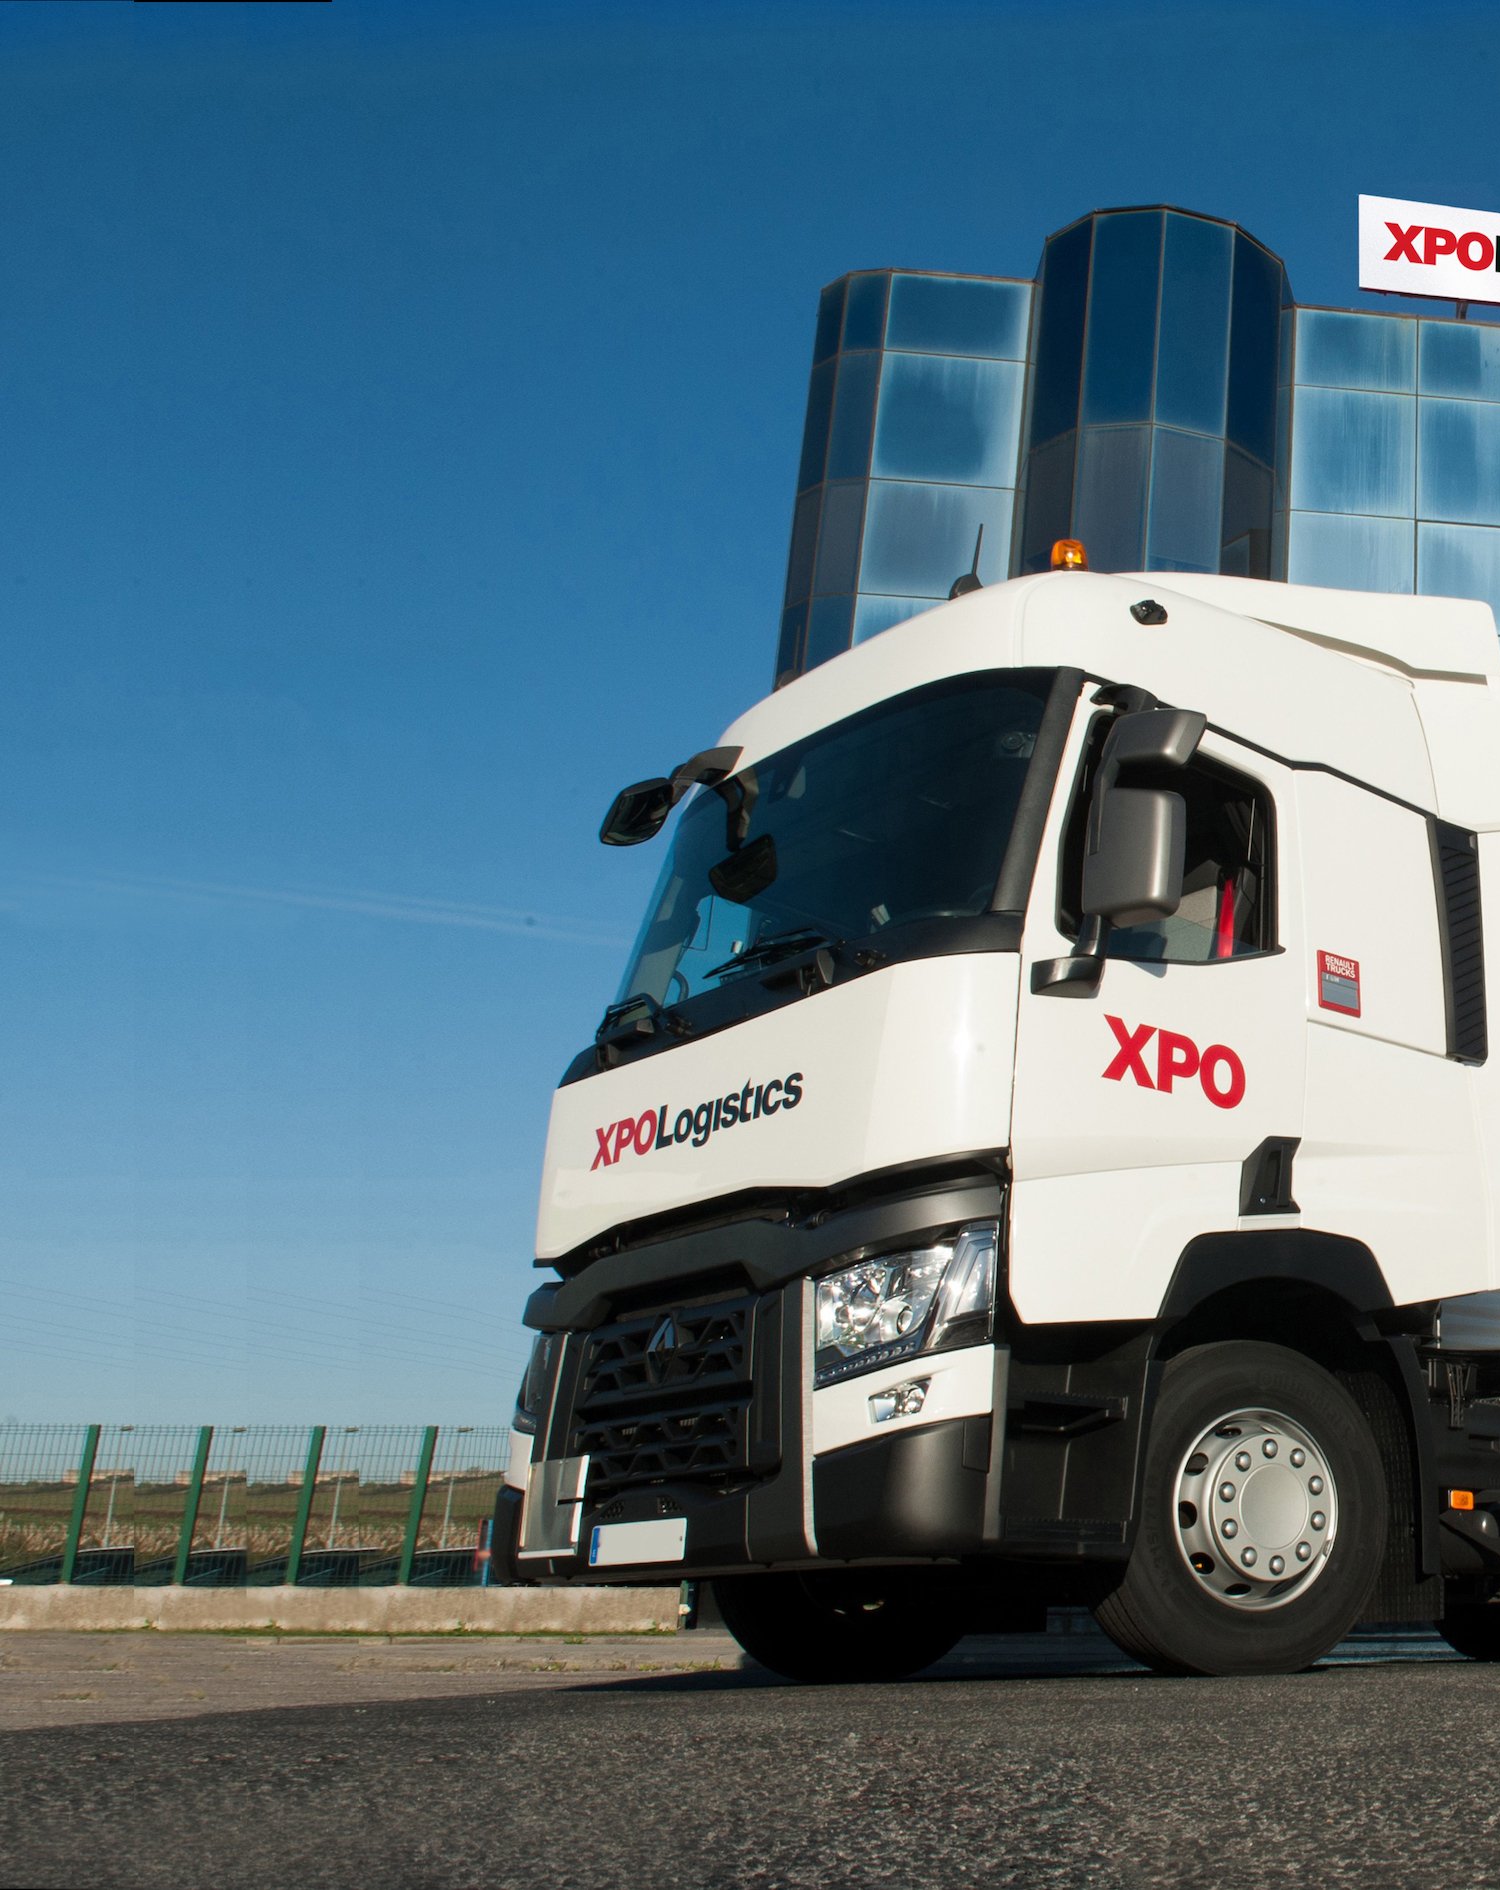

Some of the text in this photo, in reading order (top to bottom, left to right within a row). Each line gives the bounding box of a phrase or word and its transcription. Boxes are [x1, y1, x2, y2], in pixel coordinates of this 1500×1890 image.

[1325, 954, 1355, 970] RENAULT
[1326, 963, 1356, 979] TRUCKS
[1102, 1014, 1246, 1109] XPO
